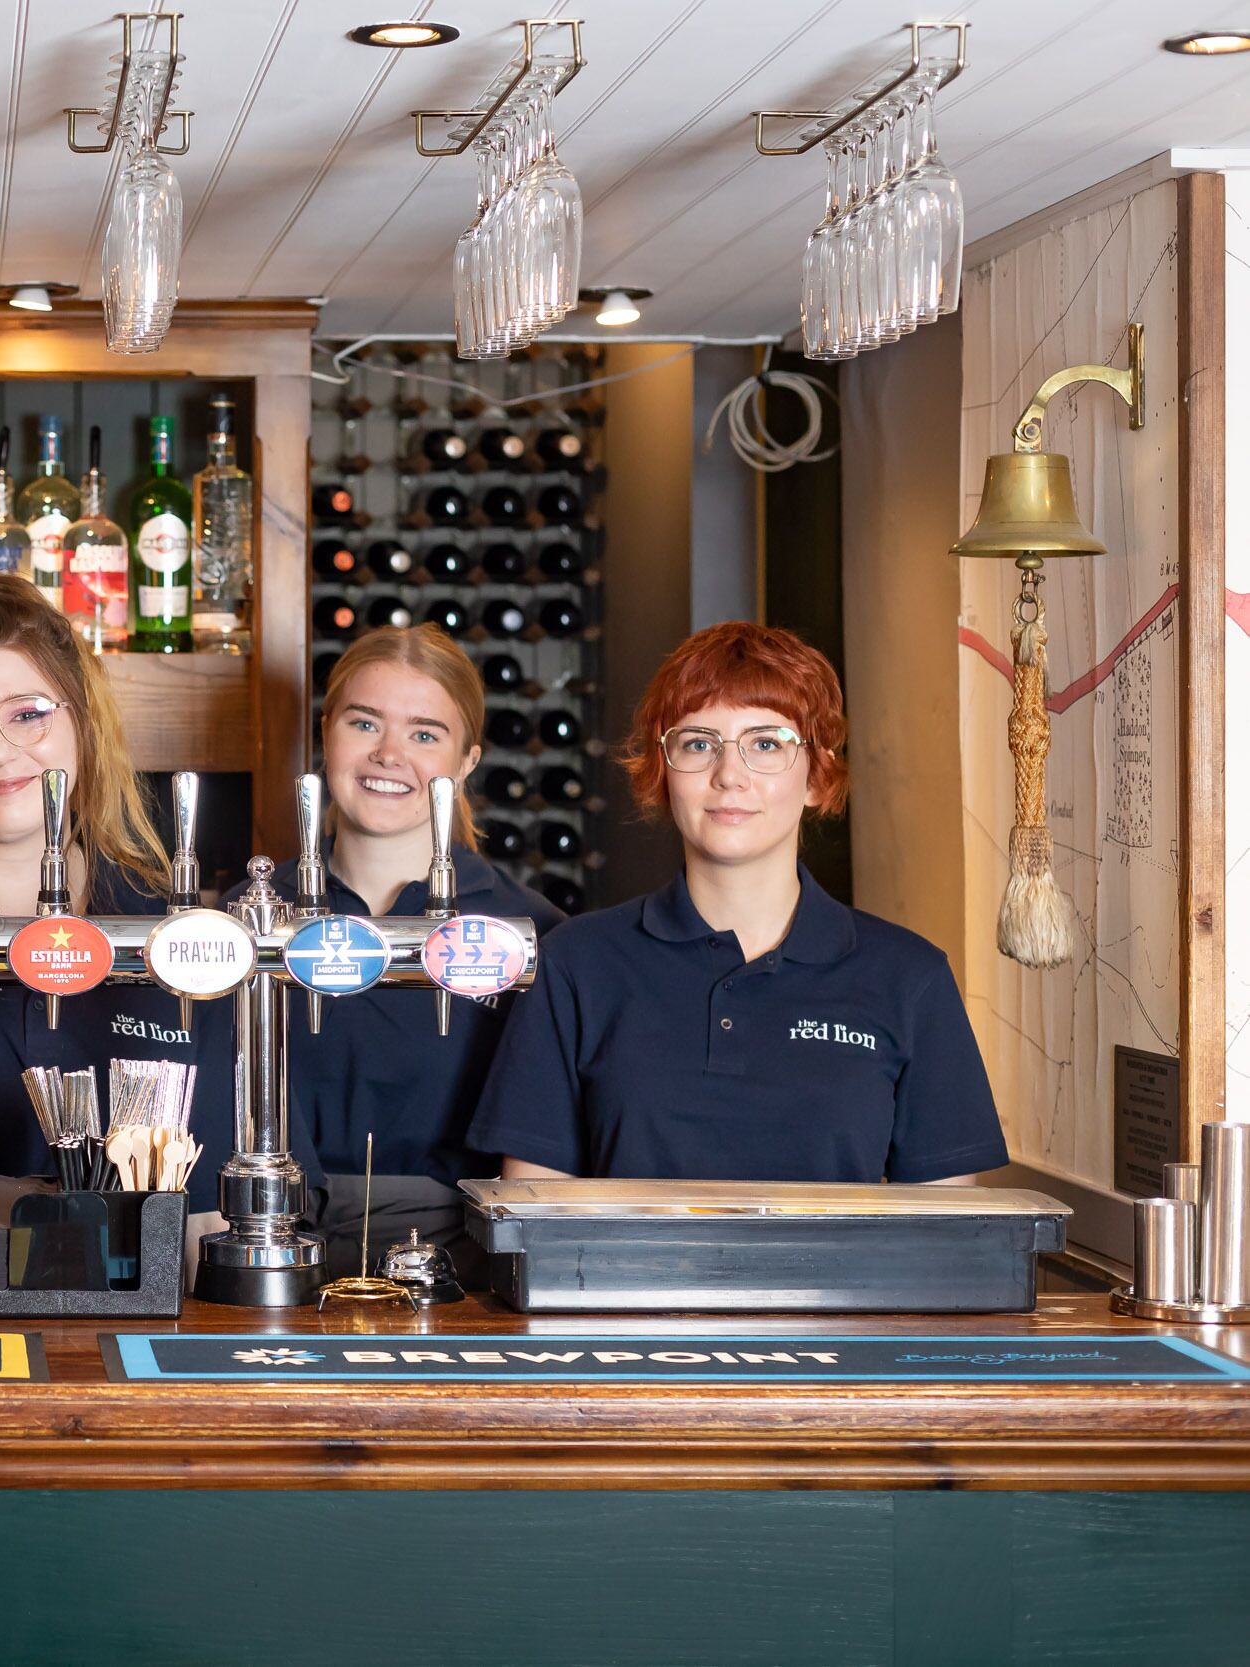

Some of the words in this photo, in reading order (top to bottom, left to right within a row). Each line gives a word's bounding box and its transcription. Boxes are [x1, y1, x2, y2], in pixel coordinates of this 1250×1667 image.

[1119, 718, 1147, 737] Haddon
[1118, 744, 1148, 768] Spinney
[30, 950, 92, 963] ESTRELLA
[168, 941, 236, 963] PRAVHA
[317, 966, 356, 974] MIDPOINT
[449, 967, 499, 976] CHECKPOINT
[116, 1013, 136, 1024] the
[797, 1019, 818, 1029] the
[110, 1020, 147, 1039] red
[148, 1022, 192, 1043] lion
[789, 1022, 830, 1041] red
[833, 1024, 876, 1050] lion
[342, 1350, 840, 1364] BREWPOINT
[895, 1354, 973, 1362] Beer
[1006, 1351, 1119, 1362] Beyond
